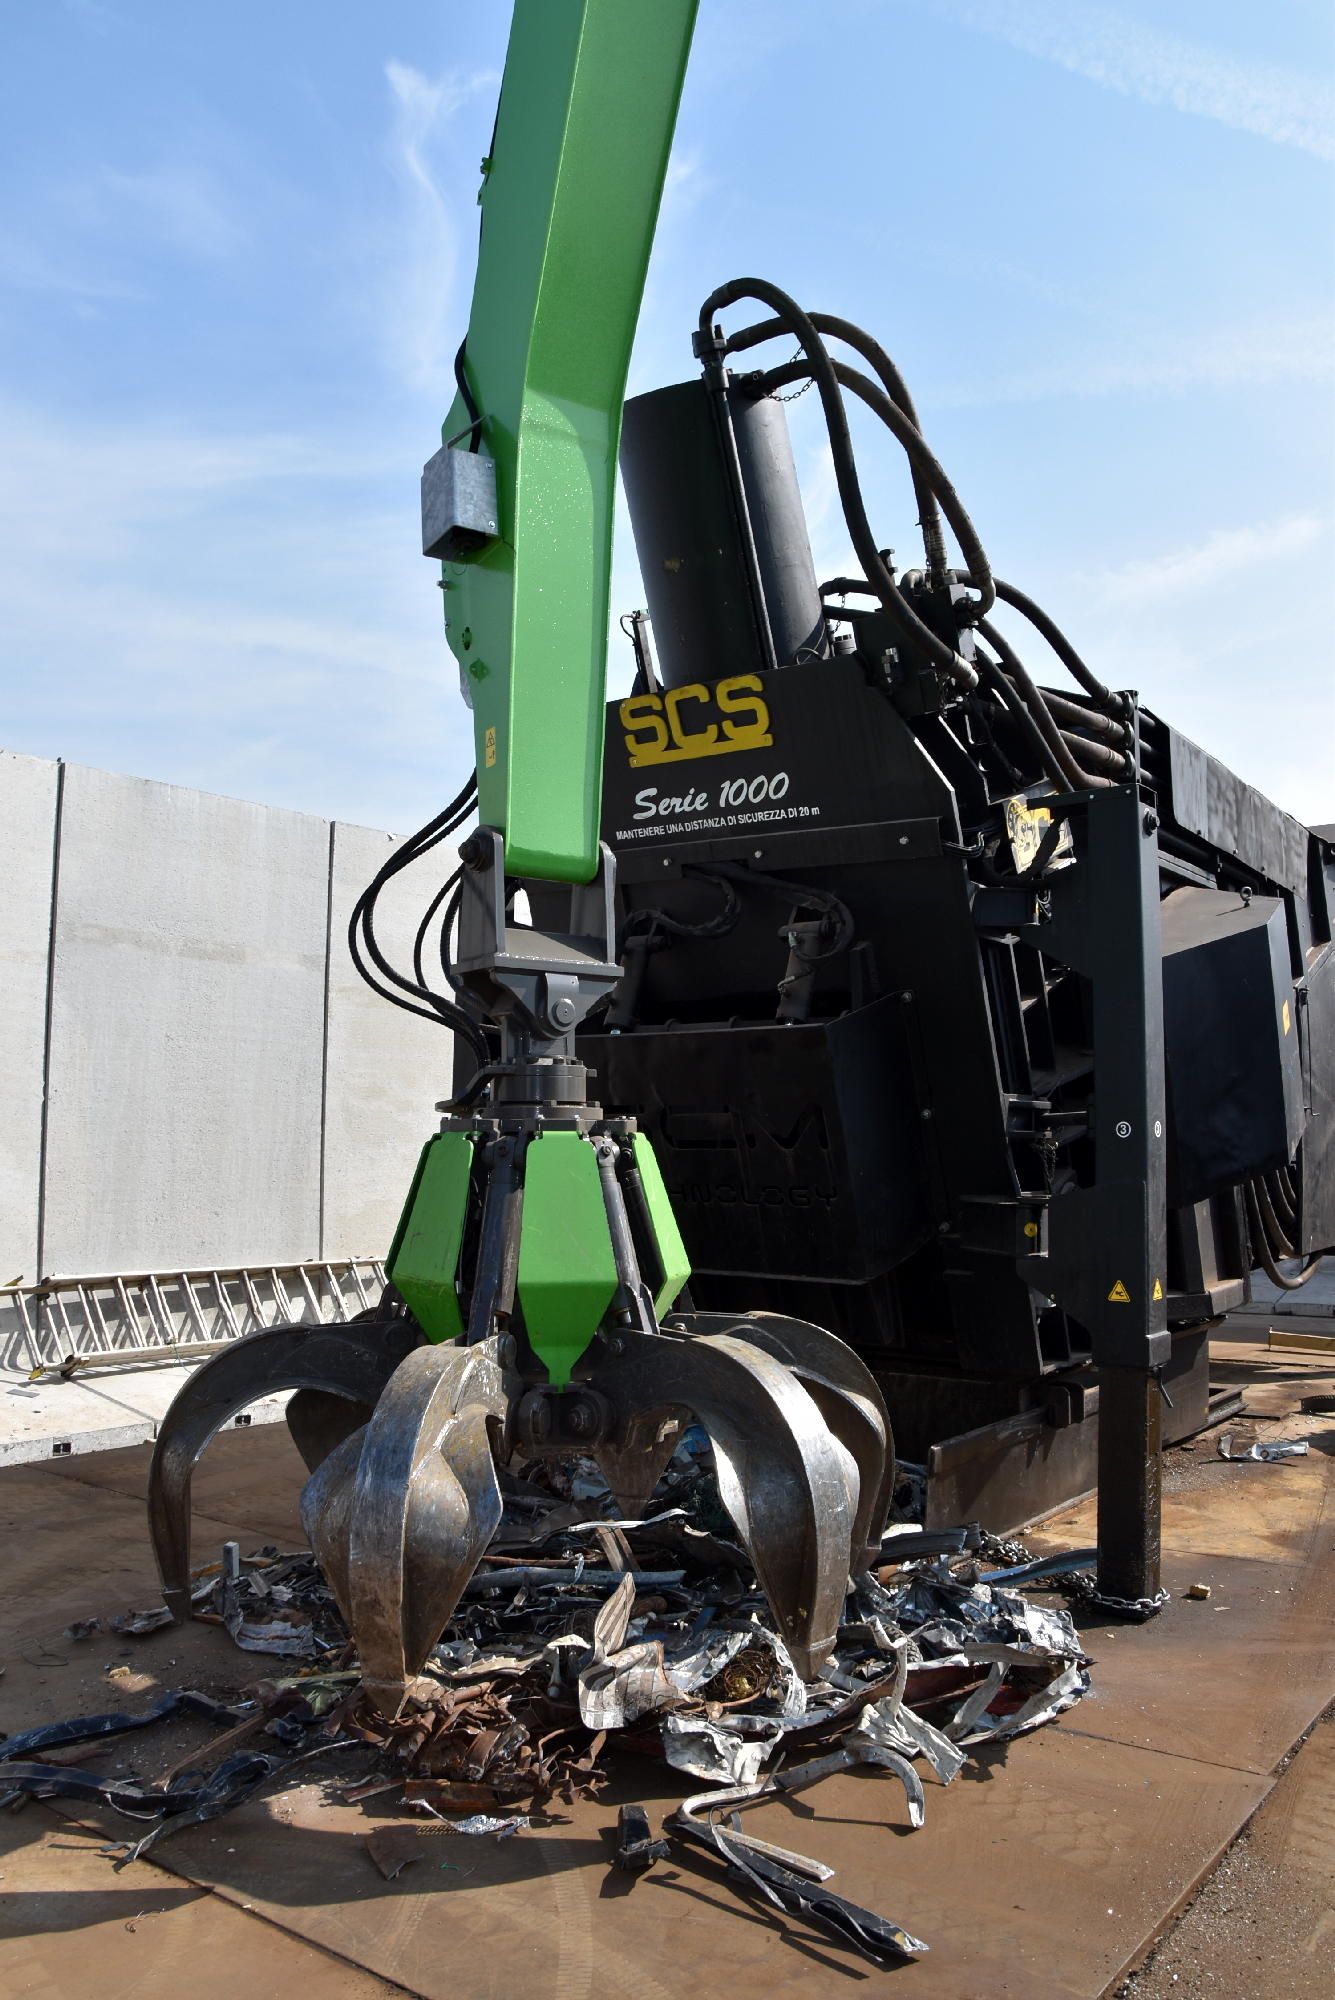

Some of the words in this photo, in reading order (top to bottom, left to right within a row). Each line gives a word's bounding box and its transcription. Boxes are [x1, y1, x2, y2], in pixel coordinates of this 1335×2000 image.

[618, 673, 772, 762] SCS
[632, 787, 709, 820] Serie
[719, 771, 790, 808] 1000
[615, 825, 665, 841] MANTENERE
[666, 822, 684, 835] UNA
[684, 817, 727, 832] DISTANZA
[727, 815, 736, 826] DI
[737, 809, 787, 825] SICUREZZA
[787, 807, 798, 819] DI
[799, 806, 810, 817] 20
[811, 806, 820, 816] m
